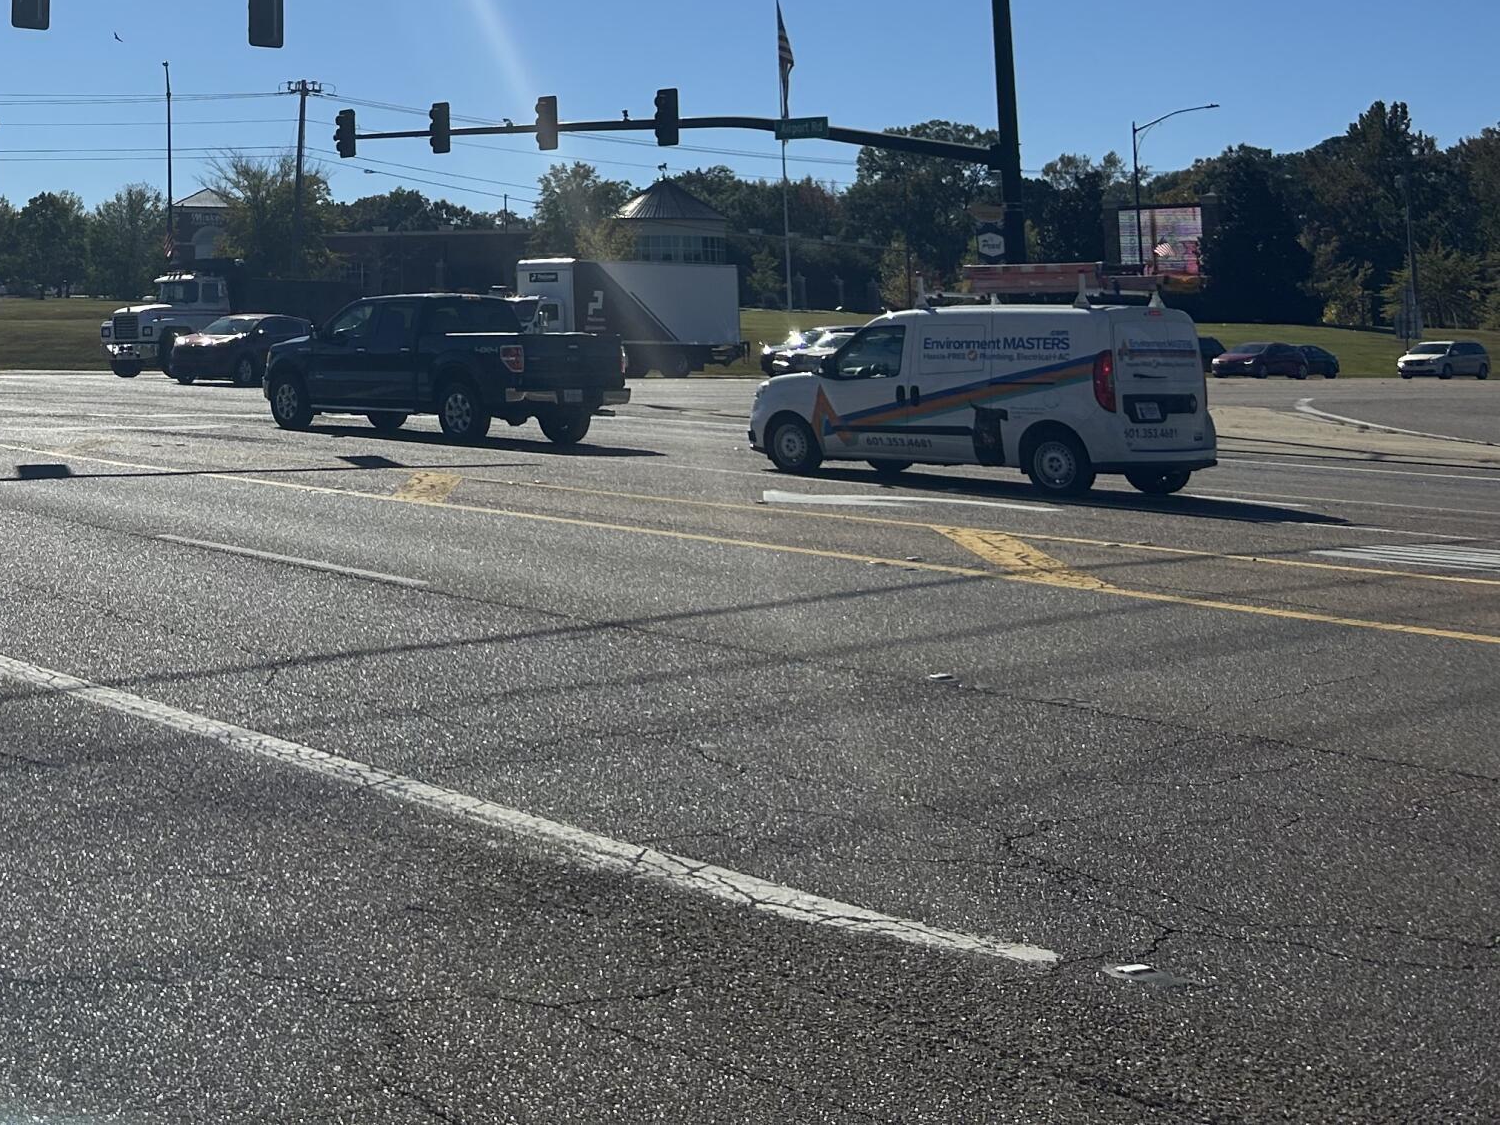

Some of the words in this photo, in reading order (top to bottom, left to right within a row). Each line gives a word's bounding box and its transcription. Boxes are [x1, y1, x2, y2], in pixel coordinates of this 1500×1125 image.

[811, 120, 823, 132] Rd
[923, 337, 1001, 350] Environment
[1003, 336, 1070, 351] MASTERS
